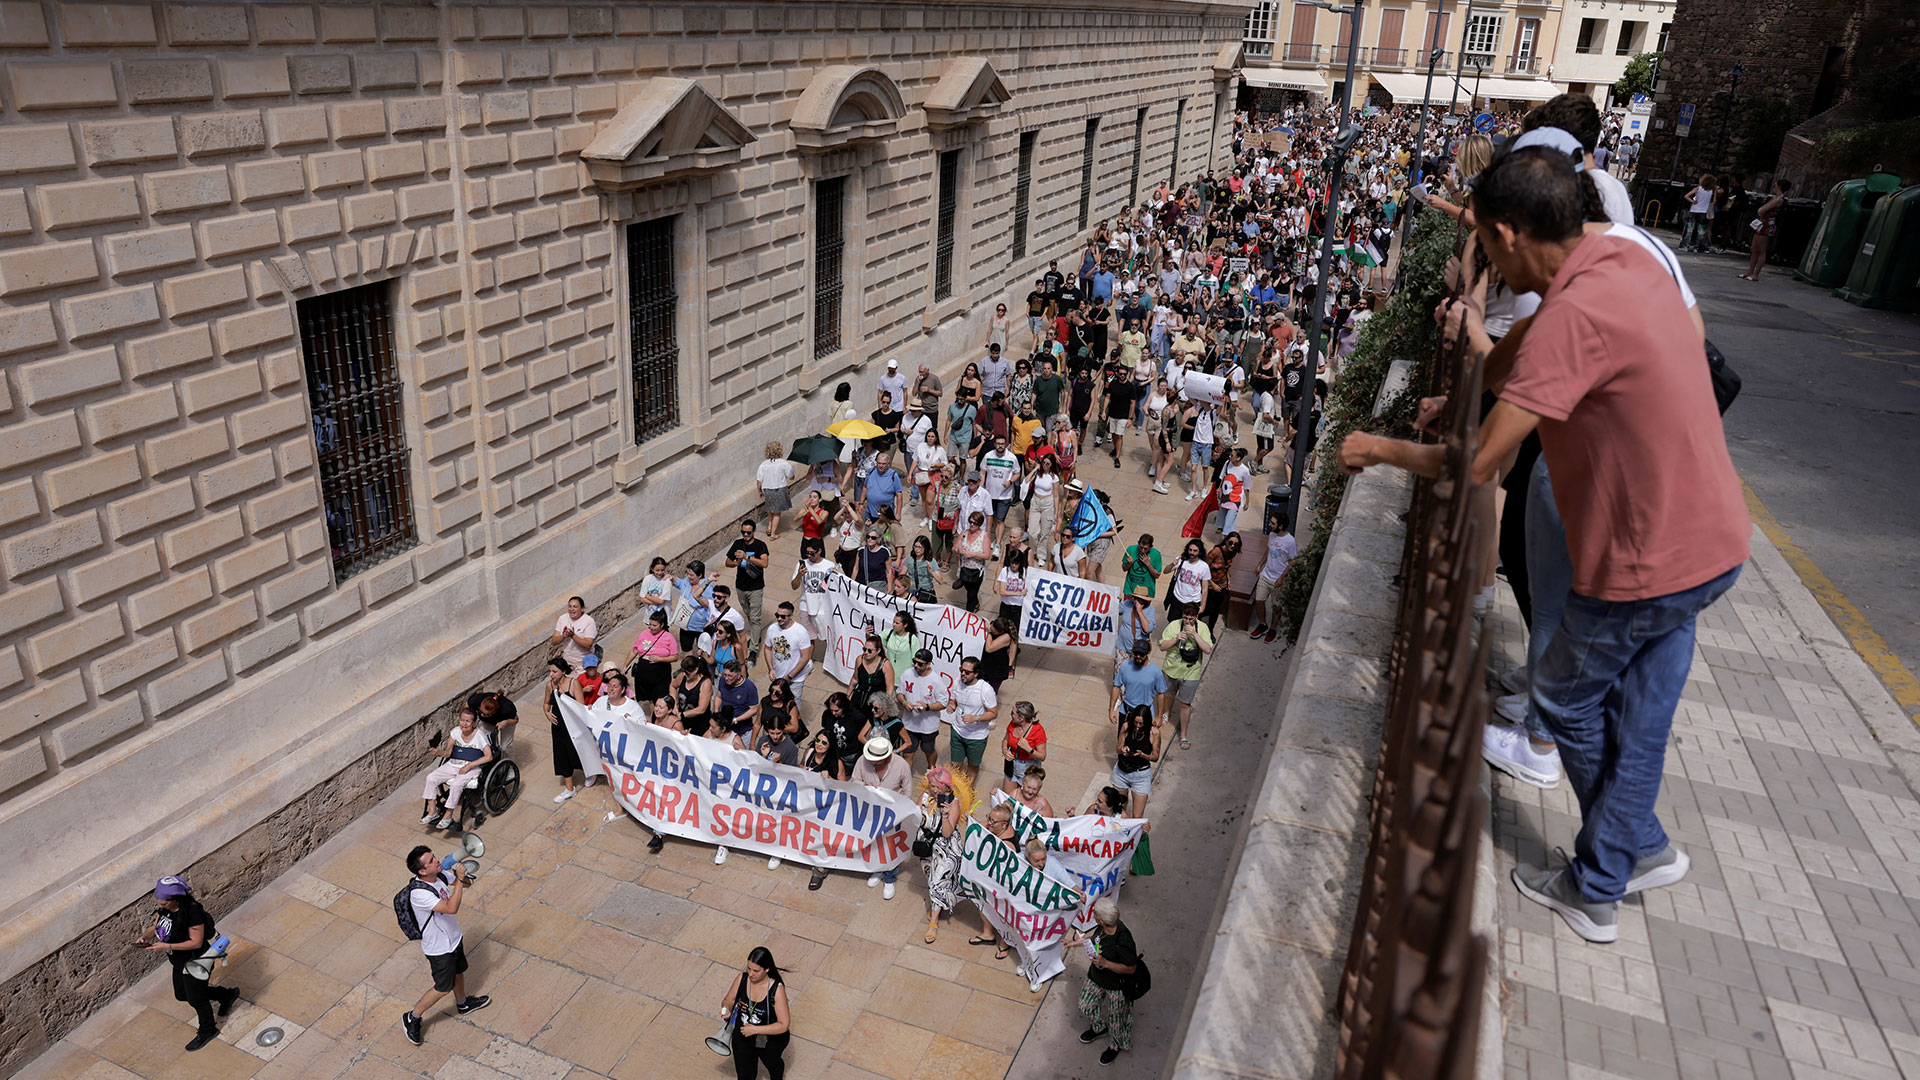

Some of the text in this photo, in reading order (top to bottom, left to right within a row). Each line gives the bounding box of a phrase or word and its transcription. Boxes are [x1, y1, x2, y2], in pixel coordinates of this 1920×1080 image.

[1030, 600, 1114, 633] SE ACABA
[1034, 578, 1085, 608] ESTO
[1086, 590, 1112, 614] NO
[937, 606, 987, 641] AVRA
[1025, 619, 1102, 648] HOY 29J
[588, 721, 699, 789] ÁLAGA
[709, 762, 798, 814] PARA
[620, 772, 700, 829] PARA
[710, 802, 911, 865] SOBREVIVIR
[962, 823, 1081, 912] CORRALAS
[960, 874, 988, 903] EN
[992, 890, 1067, 942] LUCHA
